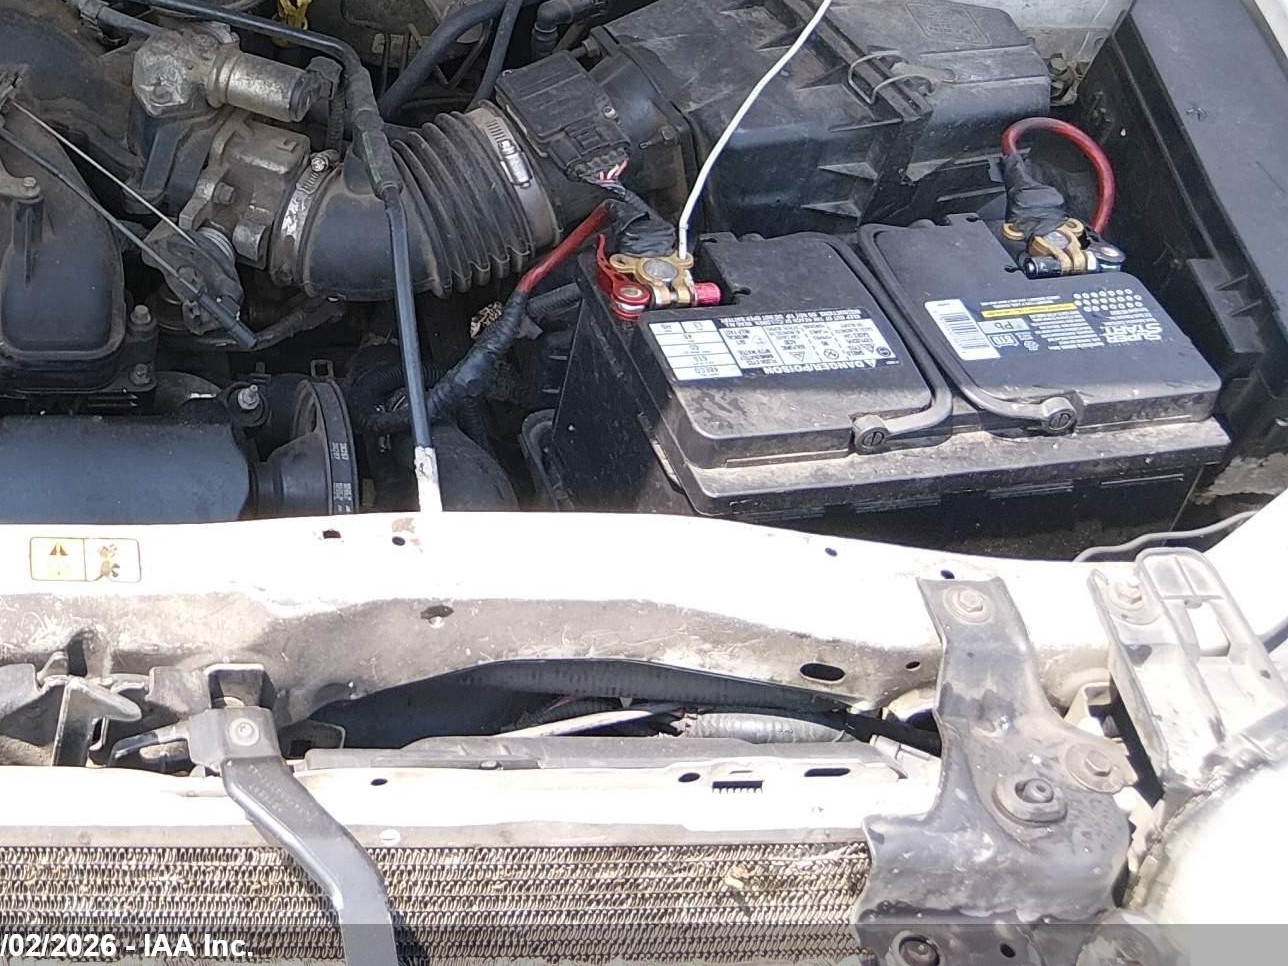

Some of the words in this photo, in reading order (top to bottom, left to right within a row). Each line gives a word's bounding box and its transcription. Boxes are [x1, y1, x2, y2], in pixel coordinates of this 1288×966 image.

[995, 322, 1014, 330] Pb
[1103, 323, 1162, 337] START
[1106, 335, 1162, 343] SUPER
[763, 360, 865, 375] DANGER/POISON
